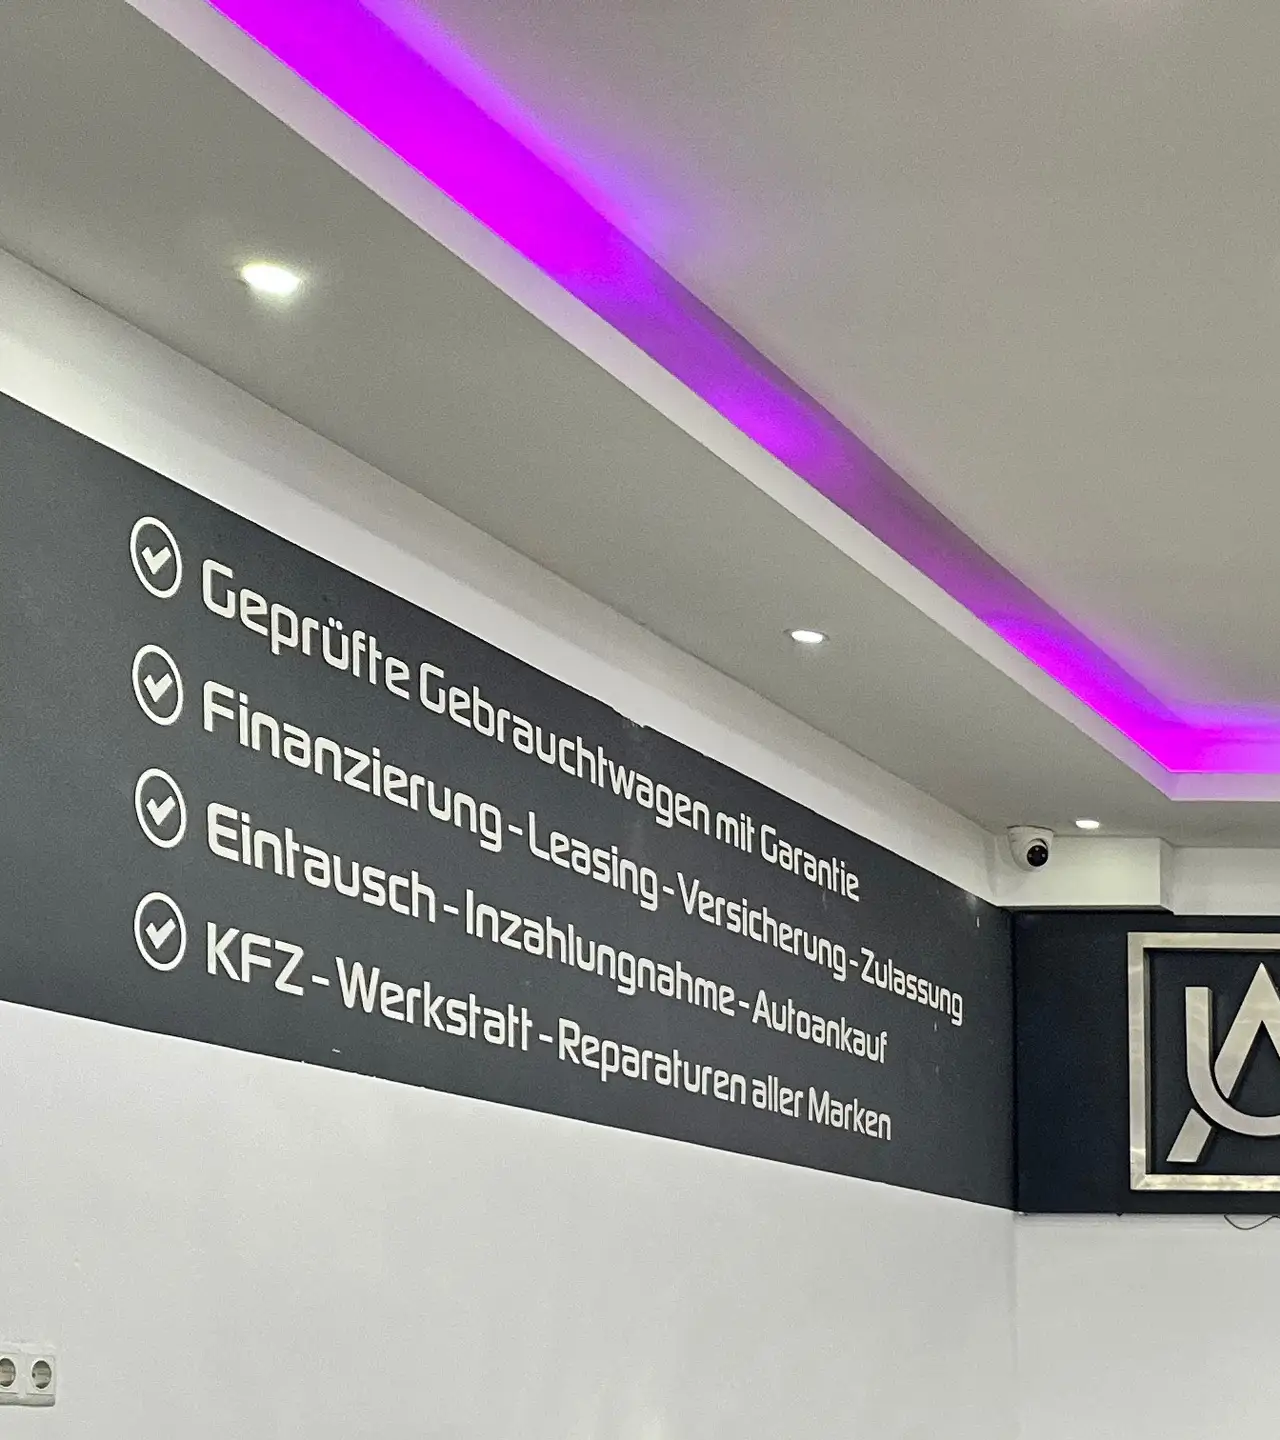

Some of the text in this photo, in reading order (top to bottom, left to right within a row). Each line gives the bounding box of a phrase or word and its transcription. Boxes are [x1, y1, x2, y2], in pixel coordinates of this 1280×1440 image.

[202, 558, 860, 902] Geprüfte Gebrauchtwagen mit Garantie
[207, 921, 305, 997] KFZ
[335, 956, 534, 1051] Werkstatt
[558, 1017, 747, 1105] Reparaturen
[752, 1074, 804, 1118] aller
[808, 1086, 892, 1141] Marken
